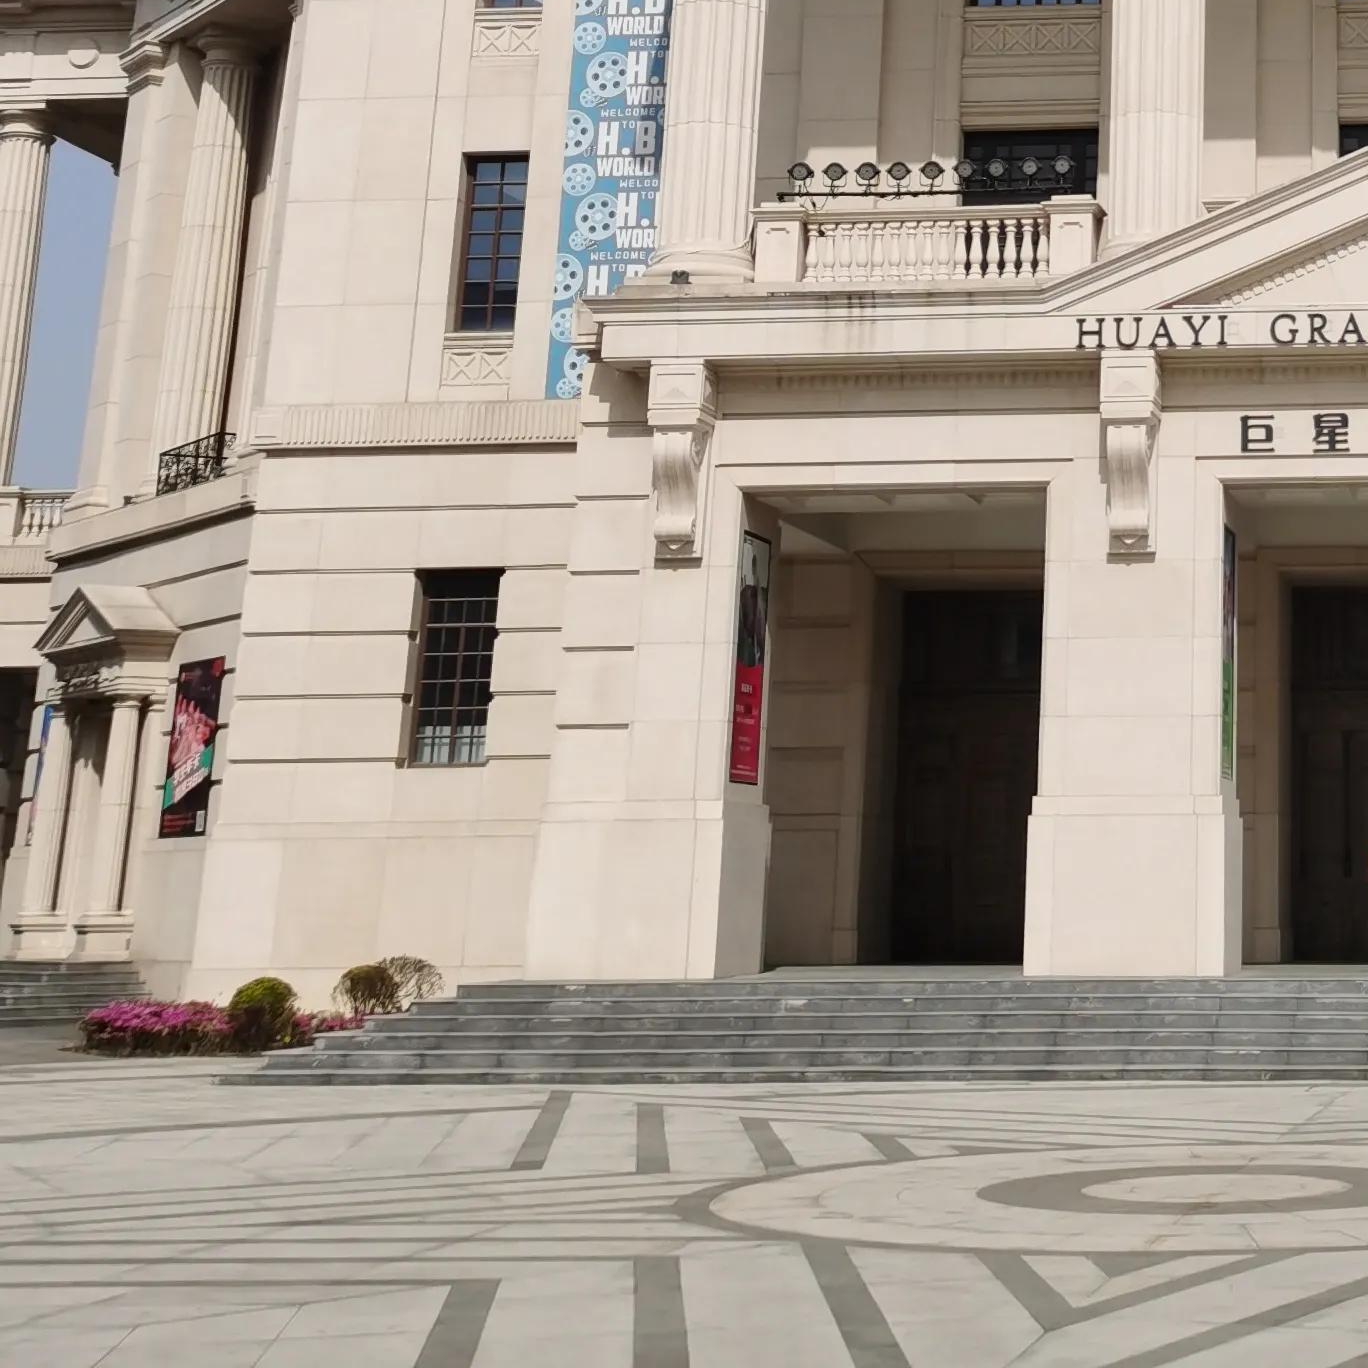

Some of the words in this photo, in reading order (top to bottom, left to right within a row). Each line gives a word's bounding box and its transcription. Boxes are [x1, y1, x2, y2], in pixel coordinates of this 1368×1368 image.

[607, 16, 664, 35] WORLD
[629, 38, 668, 47] WELCO
[651, 50, 664, 58] TO
[626, 51, 669, 85] H.
[626, 86, 665, 106] WOR
[601, 108, 656, 117] WELCOME
[622, 120, 636, 129] TO
[597, 121, 656, 155] H.B
[597, 157, 655, 176] WORLD
[620, 179, 658, 187] WELCO
[617, 192, 659, 227] H.
[616, 228, 655, 248] WOR
[590, 251, 646, 261] WELCOME
[612, 264, 625, 272] TO
[1077, 314, 1228, 349] HUAYI
